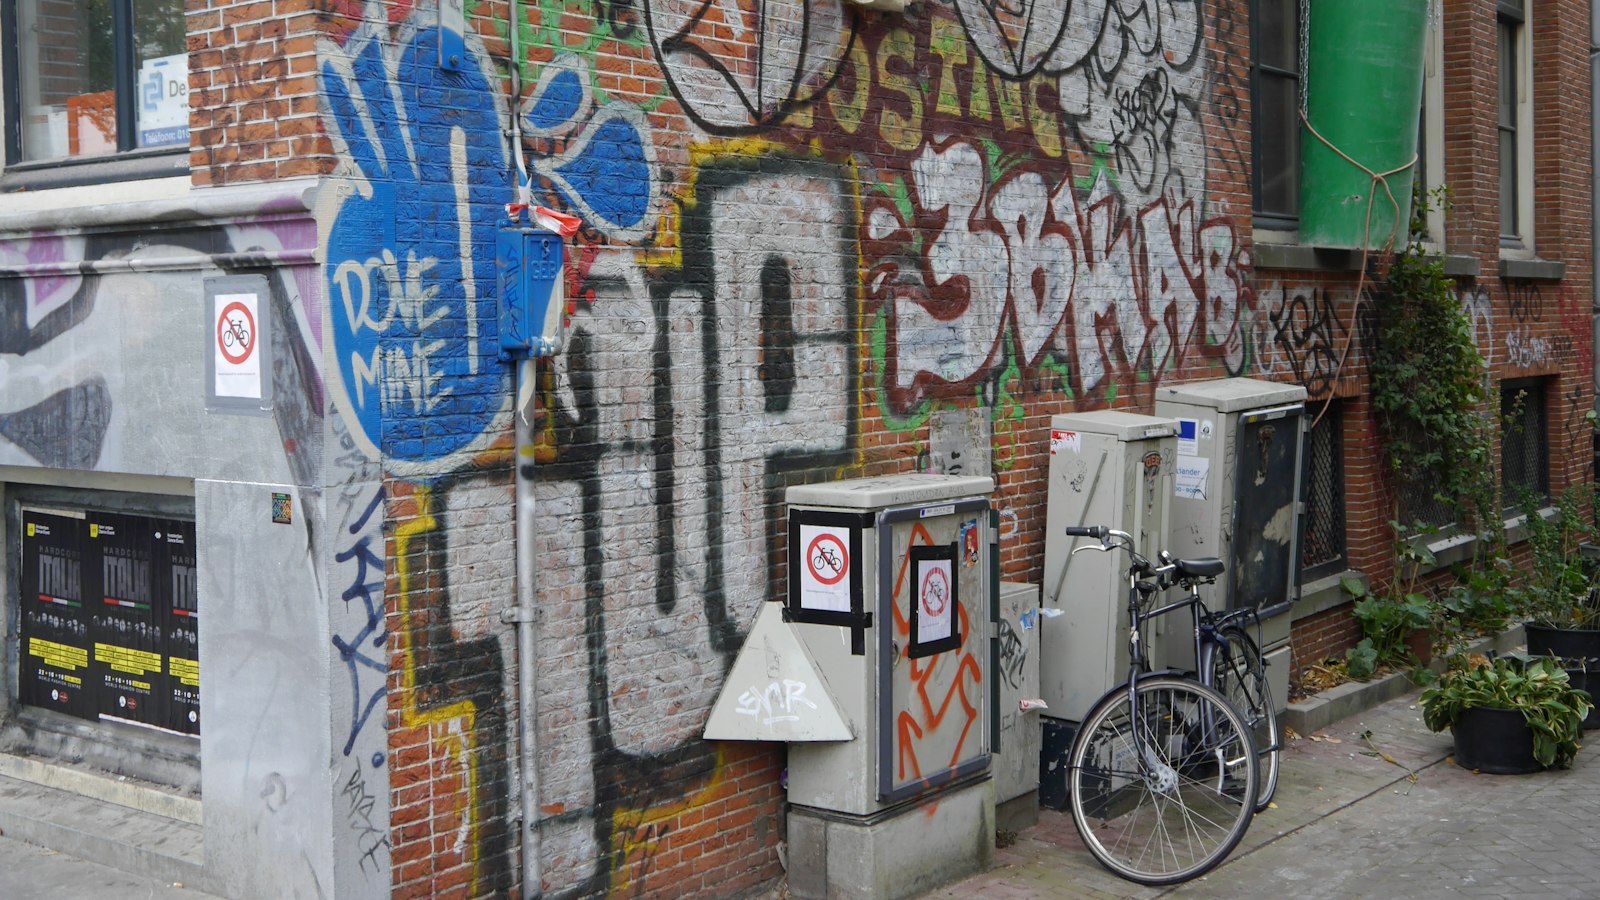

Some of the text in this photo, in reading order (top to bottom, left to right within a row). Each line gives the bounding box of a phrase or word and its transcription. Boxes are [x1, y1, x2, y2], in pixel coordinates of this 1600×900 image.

[169, 79, 186, 98] De
[39, 554, 81, 601] ITALIA
[103, 555, 150, 603] ITALIA
